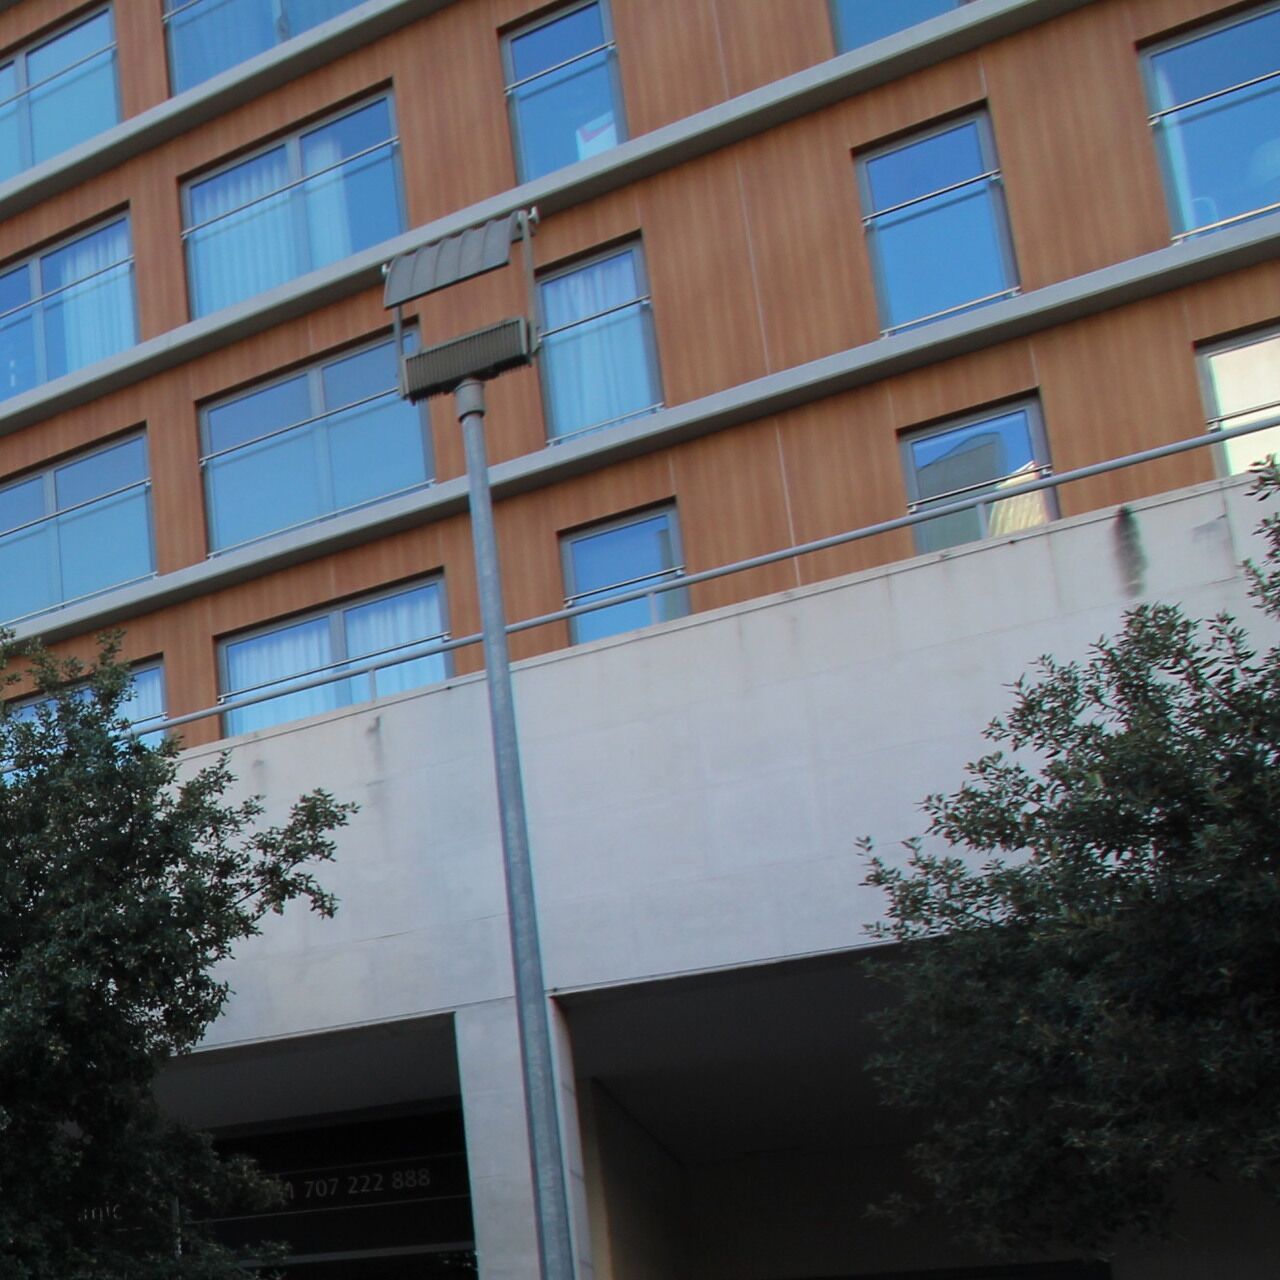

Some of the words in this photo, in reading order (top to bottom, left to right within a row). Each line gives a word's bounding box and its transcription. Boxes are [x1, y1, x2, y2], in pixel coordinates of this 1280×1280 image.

[304, 1178, 339, 1198] 707
[347, 1174, 384, 1194] 222
[392, 1169, 431, 1189] 888
